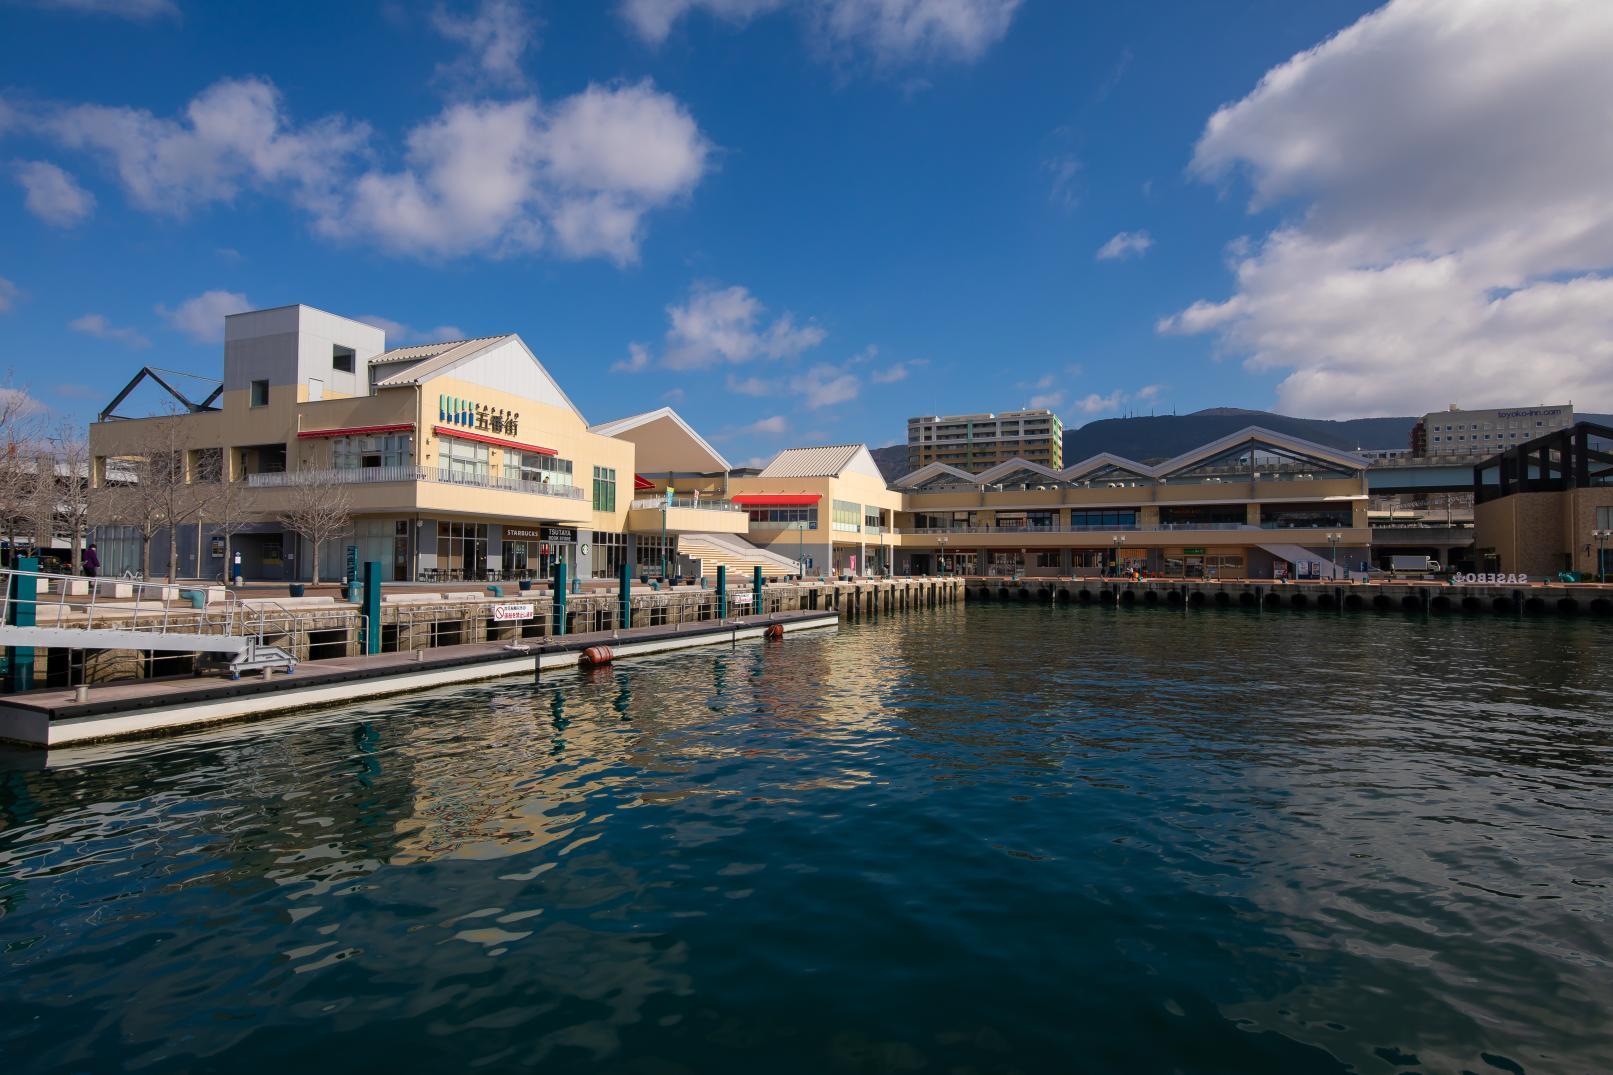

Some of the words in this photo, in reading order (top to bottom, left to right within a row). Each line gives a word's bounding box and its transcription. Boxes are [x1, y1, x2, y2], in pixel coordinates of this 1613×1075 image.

[1498, 409, 1562, 418] toyoko-inn.com
[475, 411, 518, 437] 五番街
[507, 529, 538, 537] STARBUCKS
[548, 528, 571, 536] TSUTAYA
